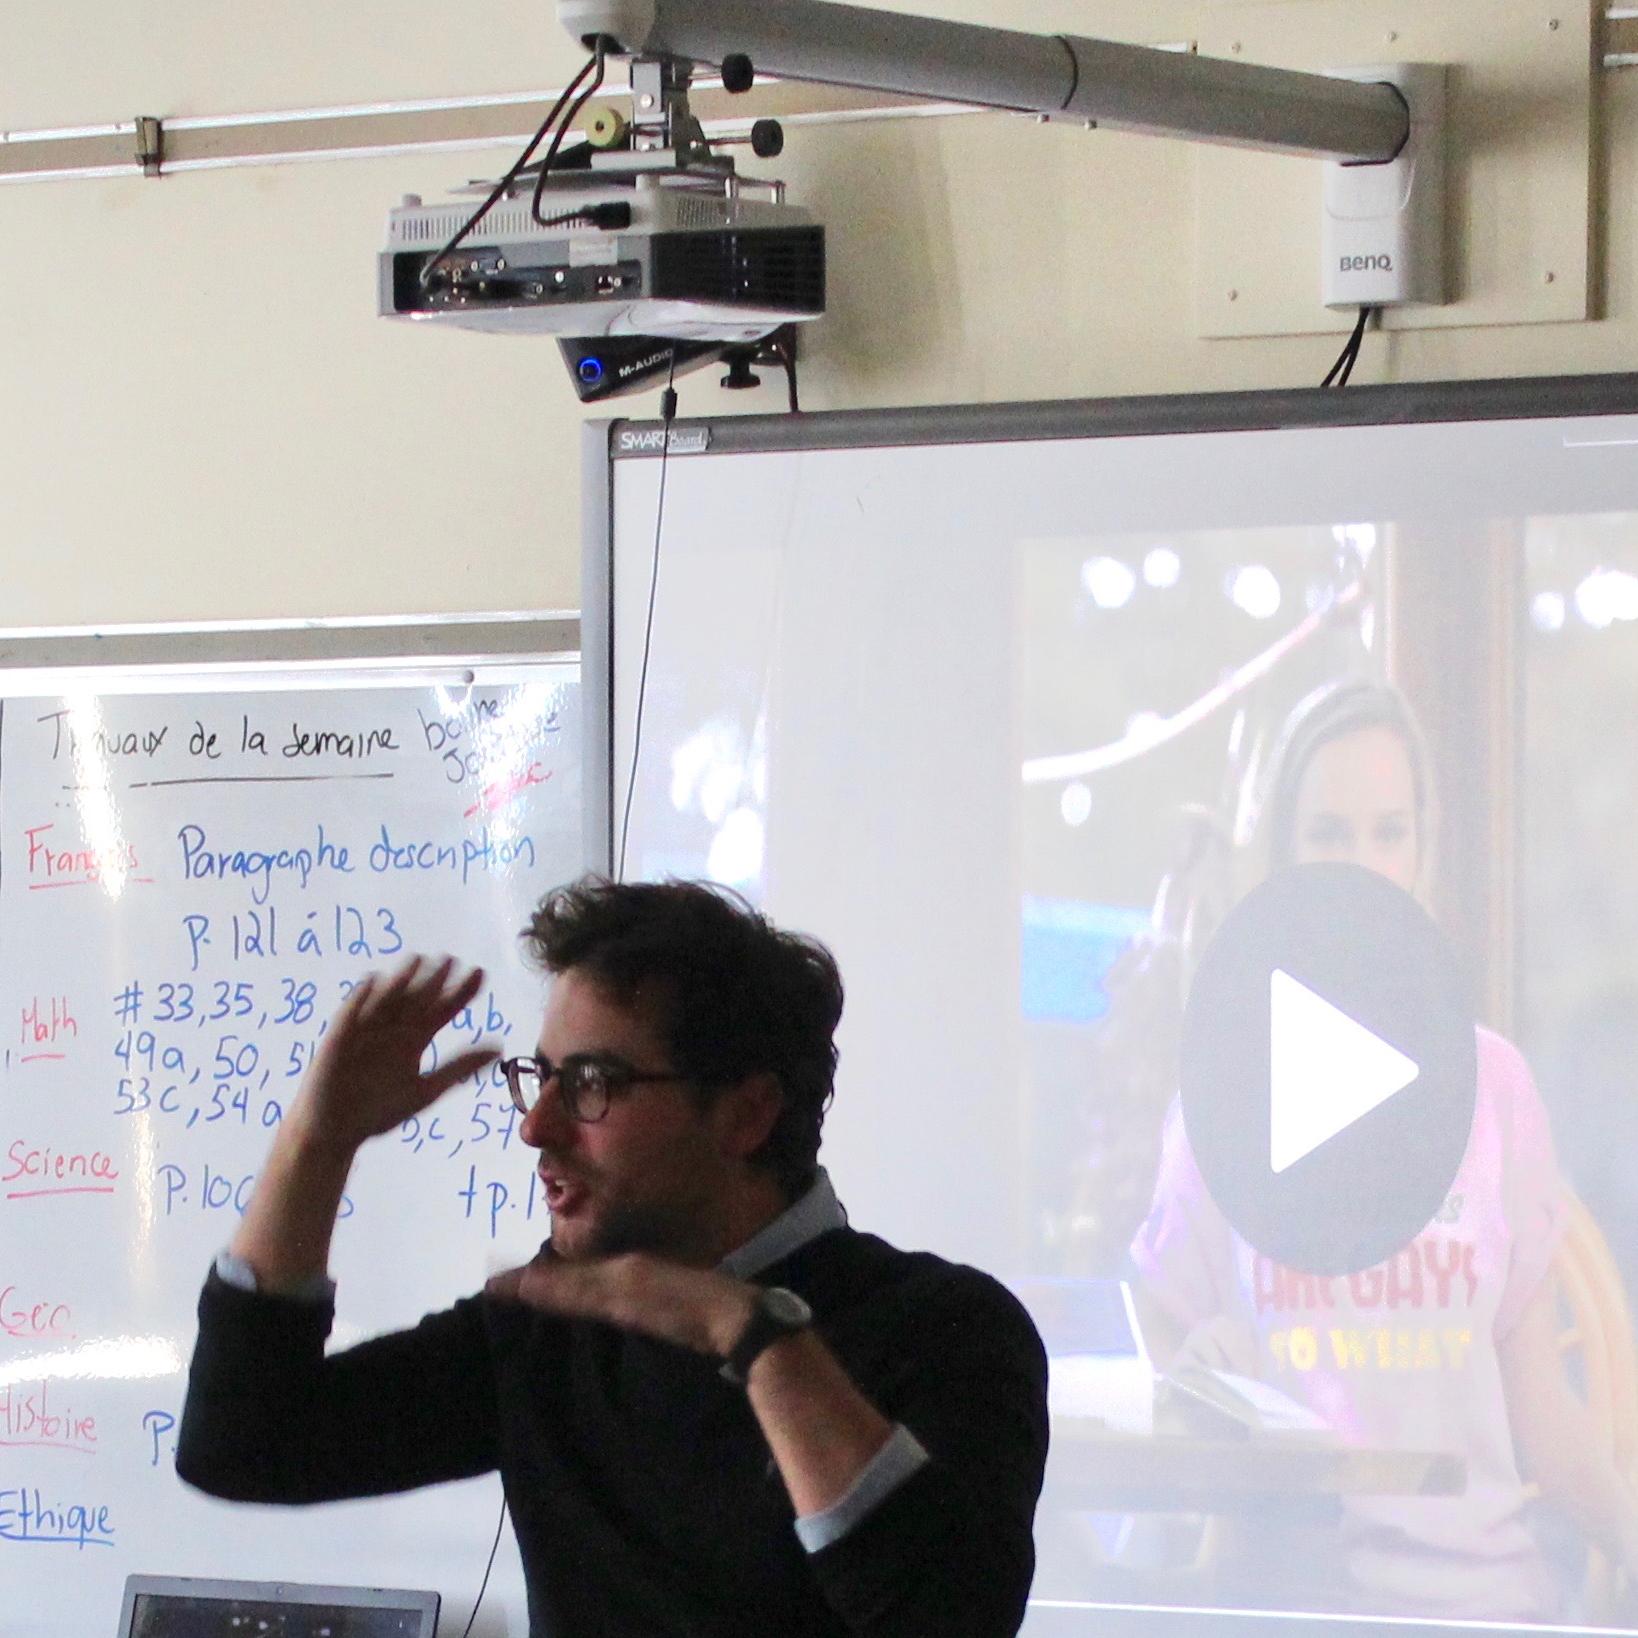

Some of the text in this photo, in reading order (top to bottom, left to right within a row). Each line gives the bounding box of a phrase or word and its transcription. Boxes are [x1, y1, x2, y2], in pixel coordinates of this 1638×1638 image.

[189, 720, 222, 756] de
[242, 714, 267, 755] la
[281, 722, 399, 761] semaine
[177, 824, 355, 904] Paragraphe
[233, 905, 277, 961] 121
[336, 903, 403, 960] 123
[21, 995, 79, 1045] Math
[2, 1140, 120, 1183] Science
